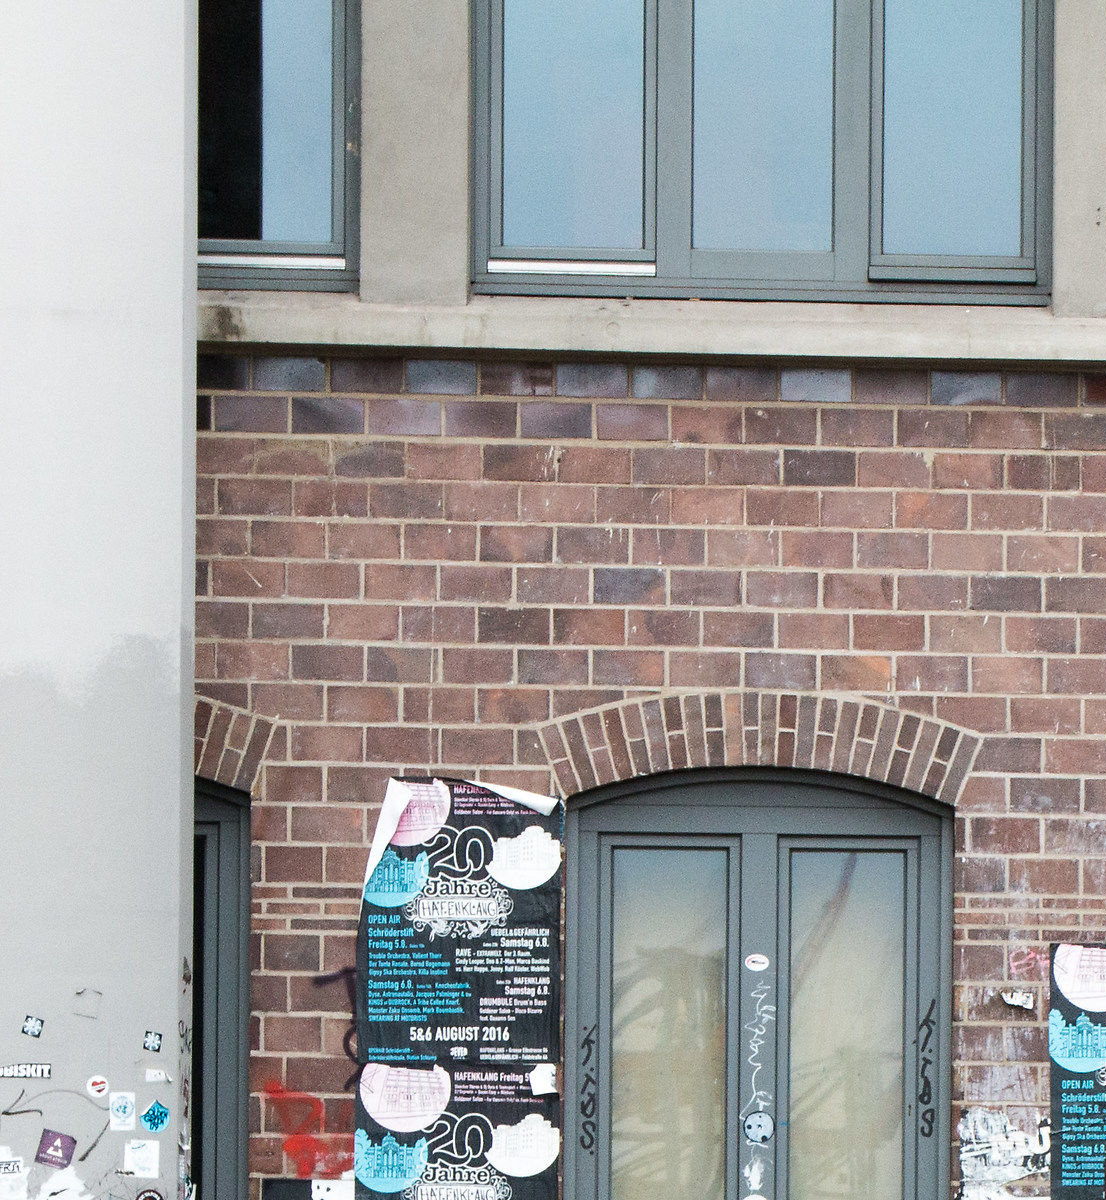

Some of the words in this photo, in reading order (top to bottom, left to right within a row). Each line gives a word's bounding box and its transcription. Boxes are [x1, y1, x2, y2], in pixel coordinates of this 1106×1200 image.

[423, 825, 494, 881] 20
[424, 879, 492, 897] Jahre
[368, 914, 387, 924] OPEN
[388, 914, 401, 924] AIR
[368, 927, 414, 937] Schröderstift
[368, 939, 393, 950] Freitag
[394, 939, 408, 949] 5.8.
[500, 937, 534, 949] Samstag
[534, 937, 549, 947] 6.8.
[455, 948, 472, 957] RAVE
[368, 980, 399, 991] Samstag
[400, 980, 414, 989] 6.8.
[504, 985, 536, 997] Samstag
[536, 985, 550, 995] 6.8.
[409, 1026, 432, 1041] 5&6
[435, 1026, 479, 1041] AUGUST
[482, 1026, 510, 1041] 2016
[454, 1072, 499, 1081] HAFENKLANG
[500, 1072, 524, 1083] Freitag
[1061, 1080, 1081, 1089] OPEN
[1082, 1080, 1094, 1089] AIR
[1062, 1092, 1106, 1102] Schröderstift
[1062, 1104, 1087, 1115] Freitag
[1087, 1104, 1101, 1114] 5.8.
[421, 1111, 494, 1169] 20
[1062, 1144, 1092, 1155] Samstag
[424, 1166, 491, 1184] Jahre
